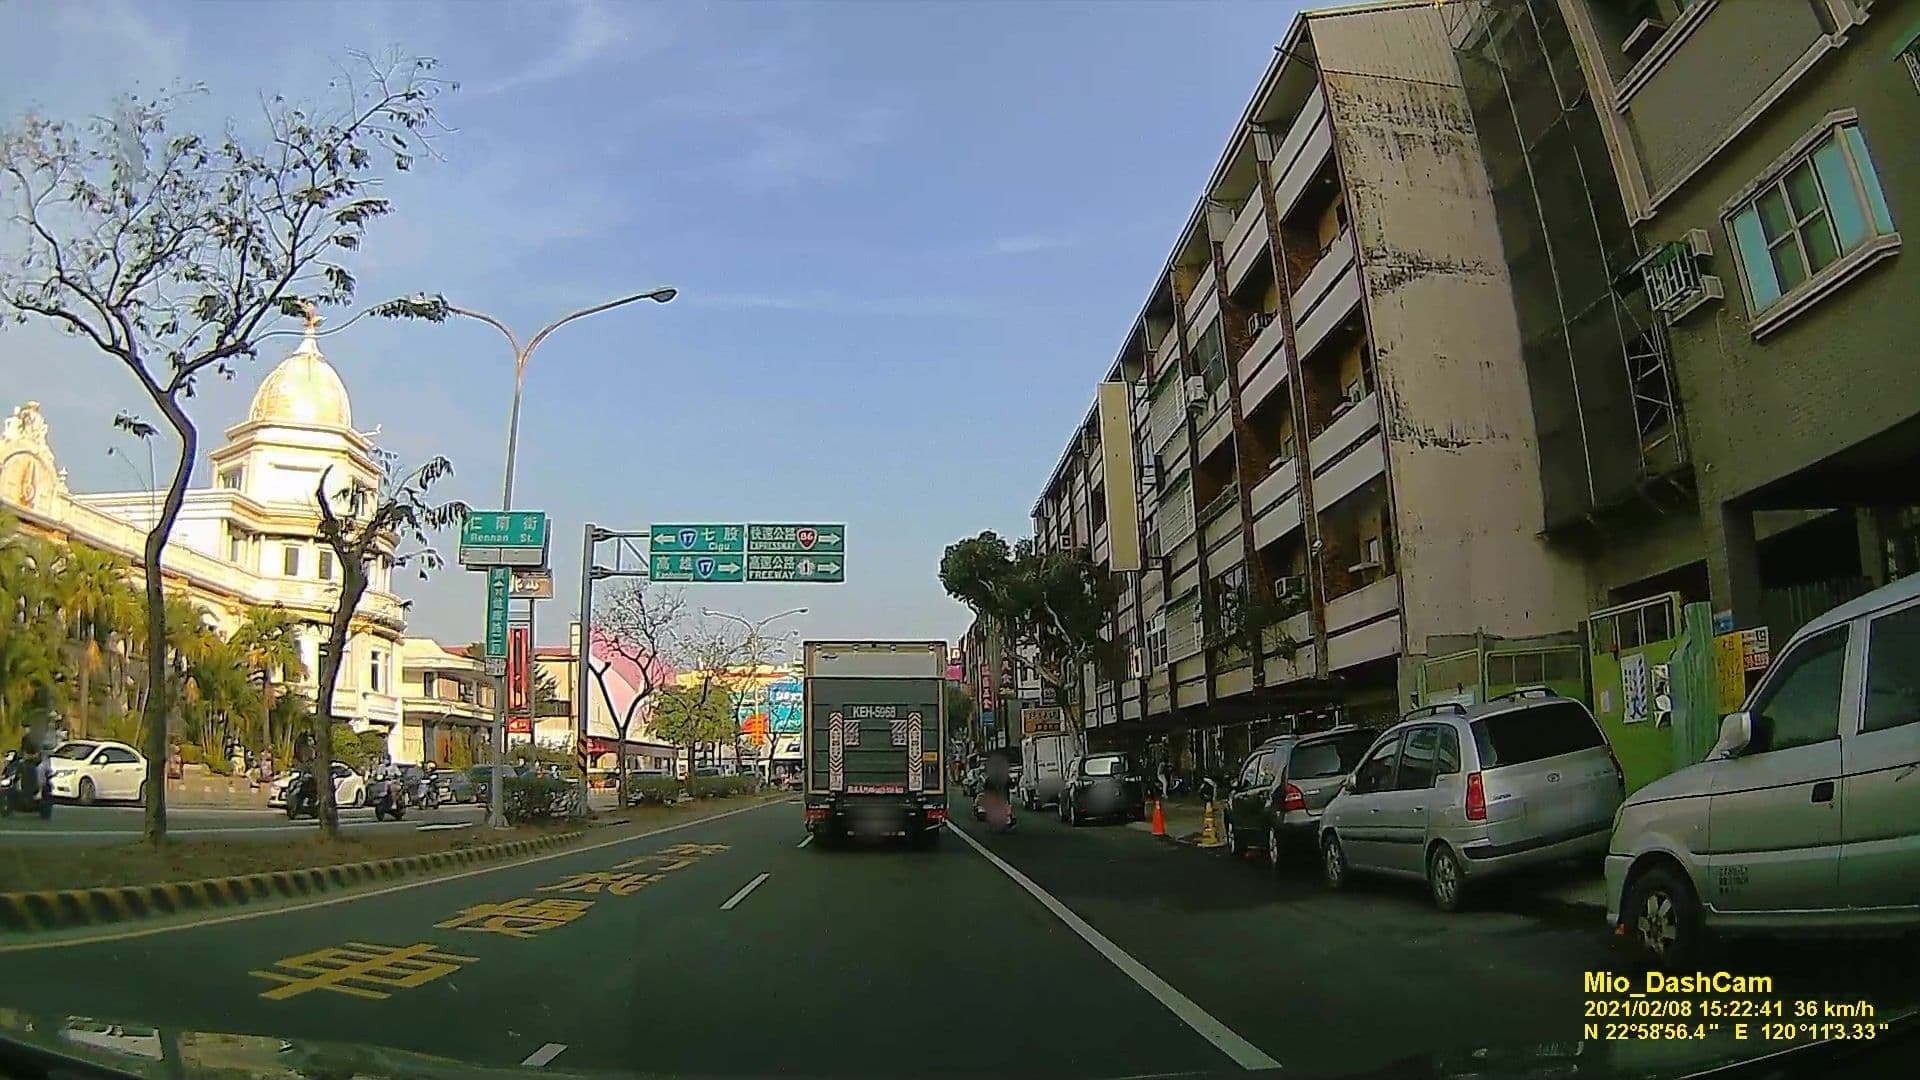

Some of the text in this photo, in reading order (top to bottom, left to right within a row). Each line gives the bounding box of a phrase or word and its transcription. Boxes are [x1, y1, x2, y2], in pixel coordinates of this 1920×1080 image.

[464, 516, 538, 532] 仁南街
[471, 533, 509, 542] Rennan
[699, 527, 739, 541] 七股
[751, 527, 796, 541] 快速公路
[708, 542, 730, 552] Cigu
[656, 556, 694, 570] 高雄
[749, 556, 795, 570] 高速公路
[749, 571, 795, 579] FREEWAY
